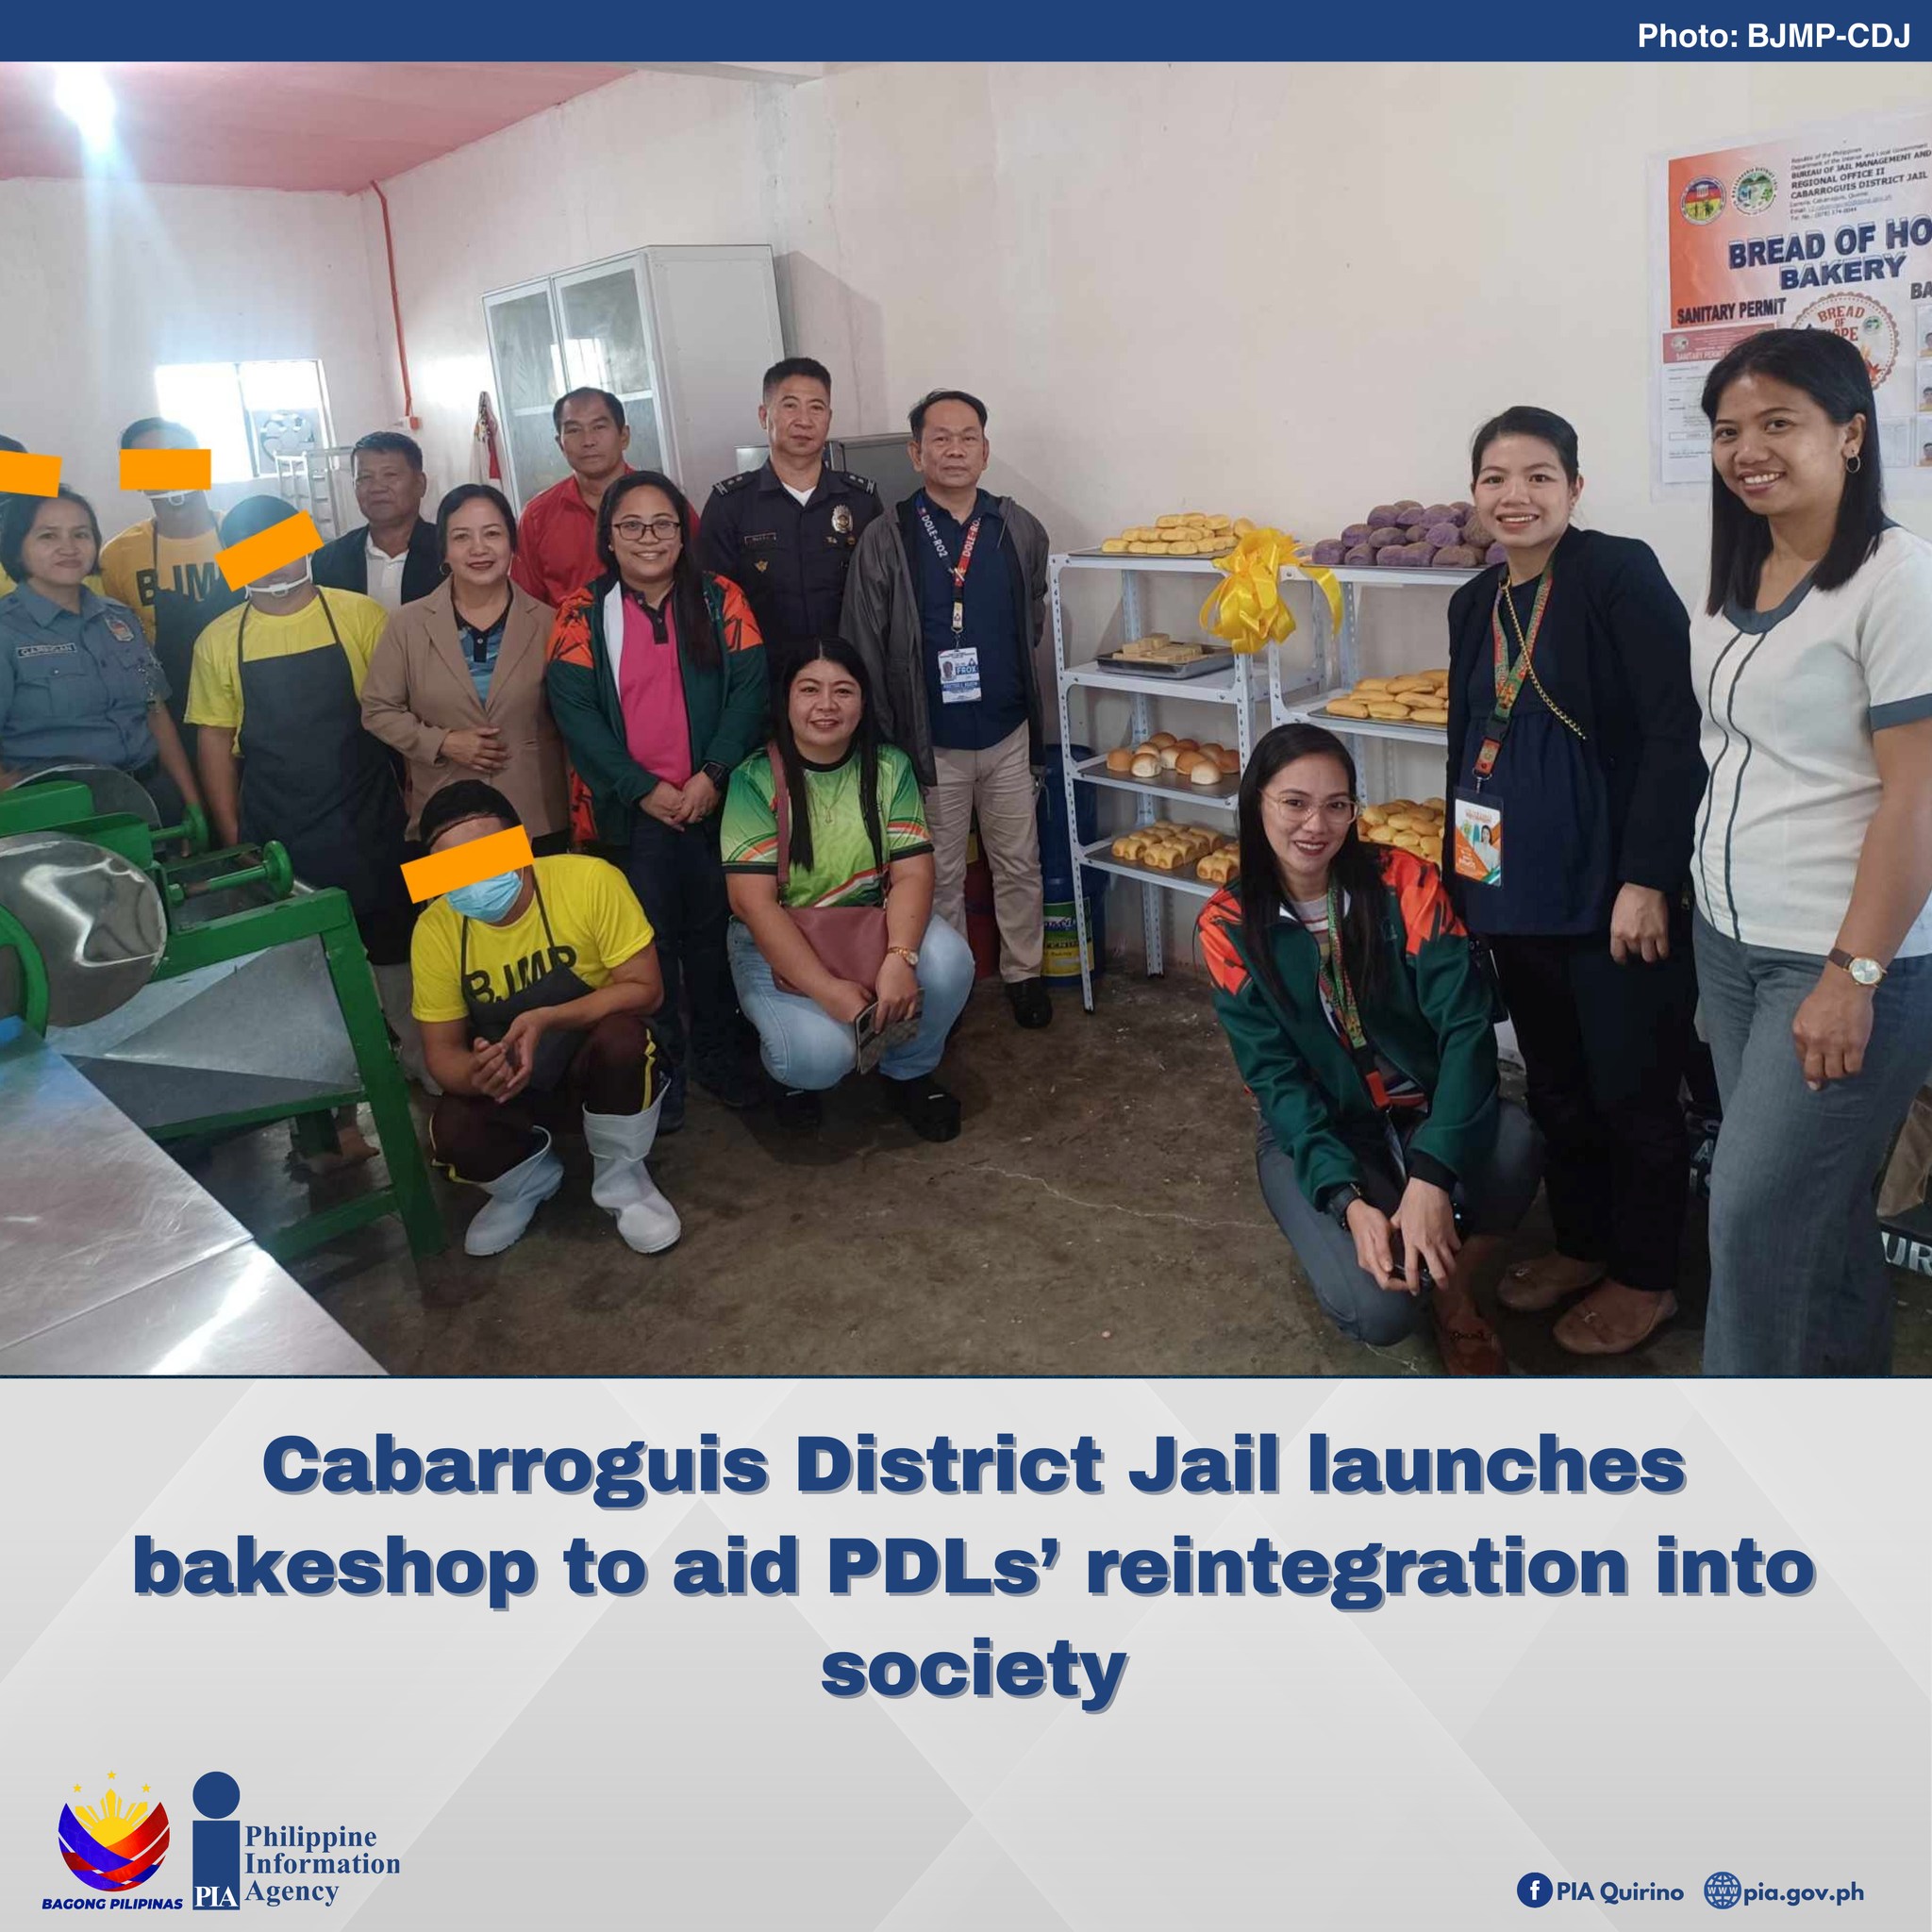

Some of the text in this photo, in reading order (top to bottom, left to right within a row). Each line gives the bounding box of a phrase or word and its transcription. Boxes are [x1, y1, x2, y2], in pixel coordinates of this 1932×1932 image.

[1791, 168, 1822, 179] BUREAU
[1837, 163, 1853, 172] JAIL
[1855, 154, 1912, 169] MANAGEMENT
[1914, 150, 1932, 159] AND
[1791, 167, 1885, 190] REGIONAL OFFICE II
[1790, 171, 1928, 199] CABARROGUIS DISTRICT JAIL
[1728, 214, 1932, 270] BREAD OF HO
[1780, 252, 1907, 291] BAKERY
[1677, 297, 1787, 325] SANITARY PERMIT
[1817, 306, 1865, 323] BREAD
[1835, 318, 1846, 327] OF
[1833, 326, 1858, 341] OPE
[921, 514, 948, 558] DOLE-RO2
[962, 517, 981, 557] DOLE-RO
[462, 945, 577, 1006] BJMP
